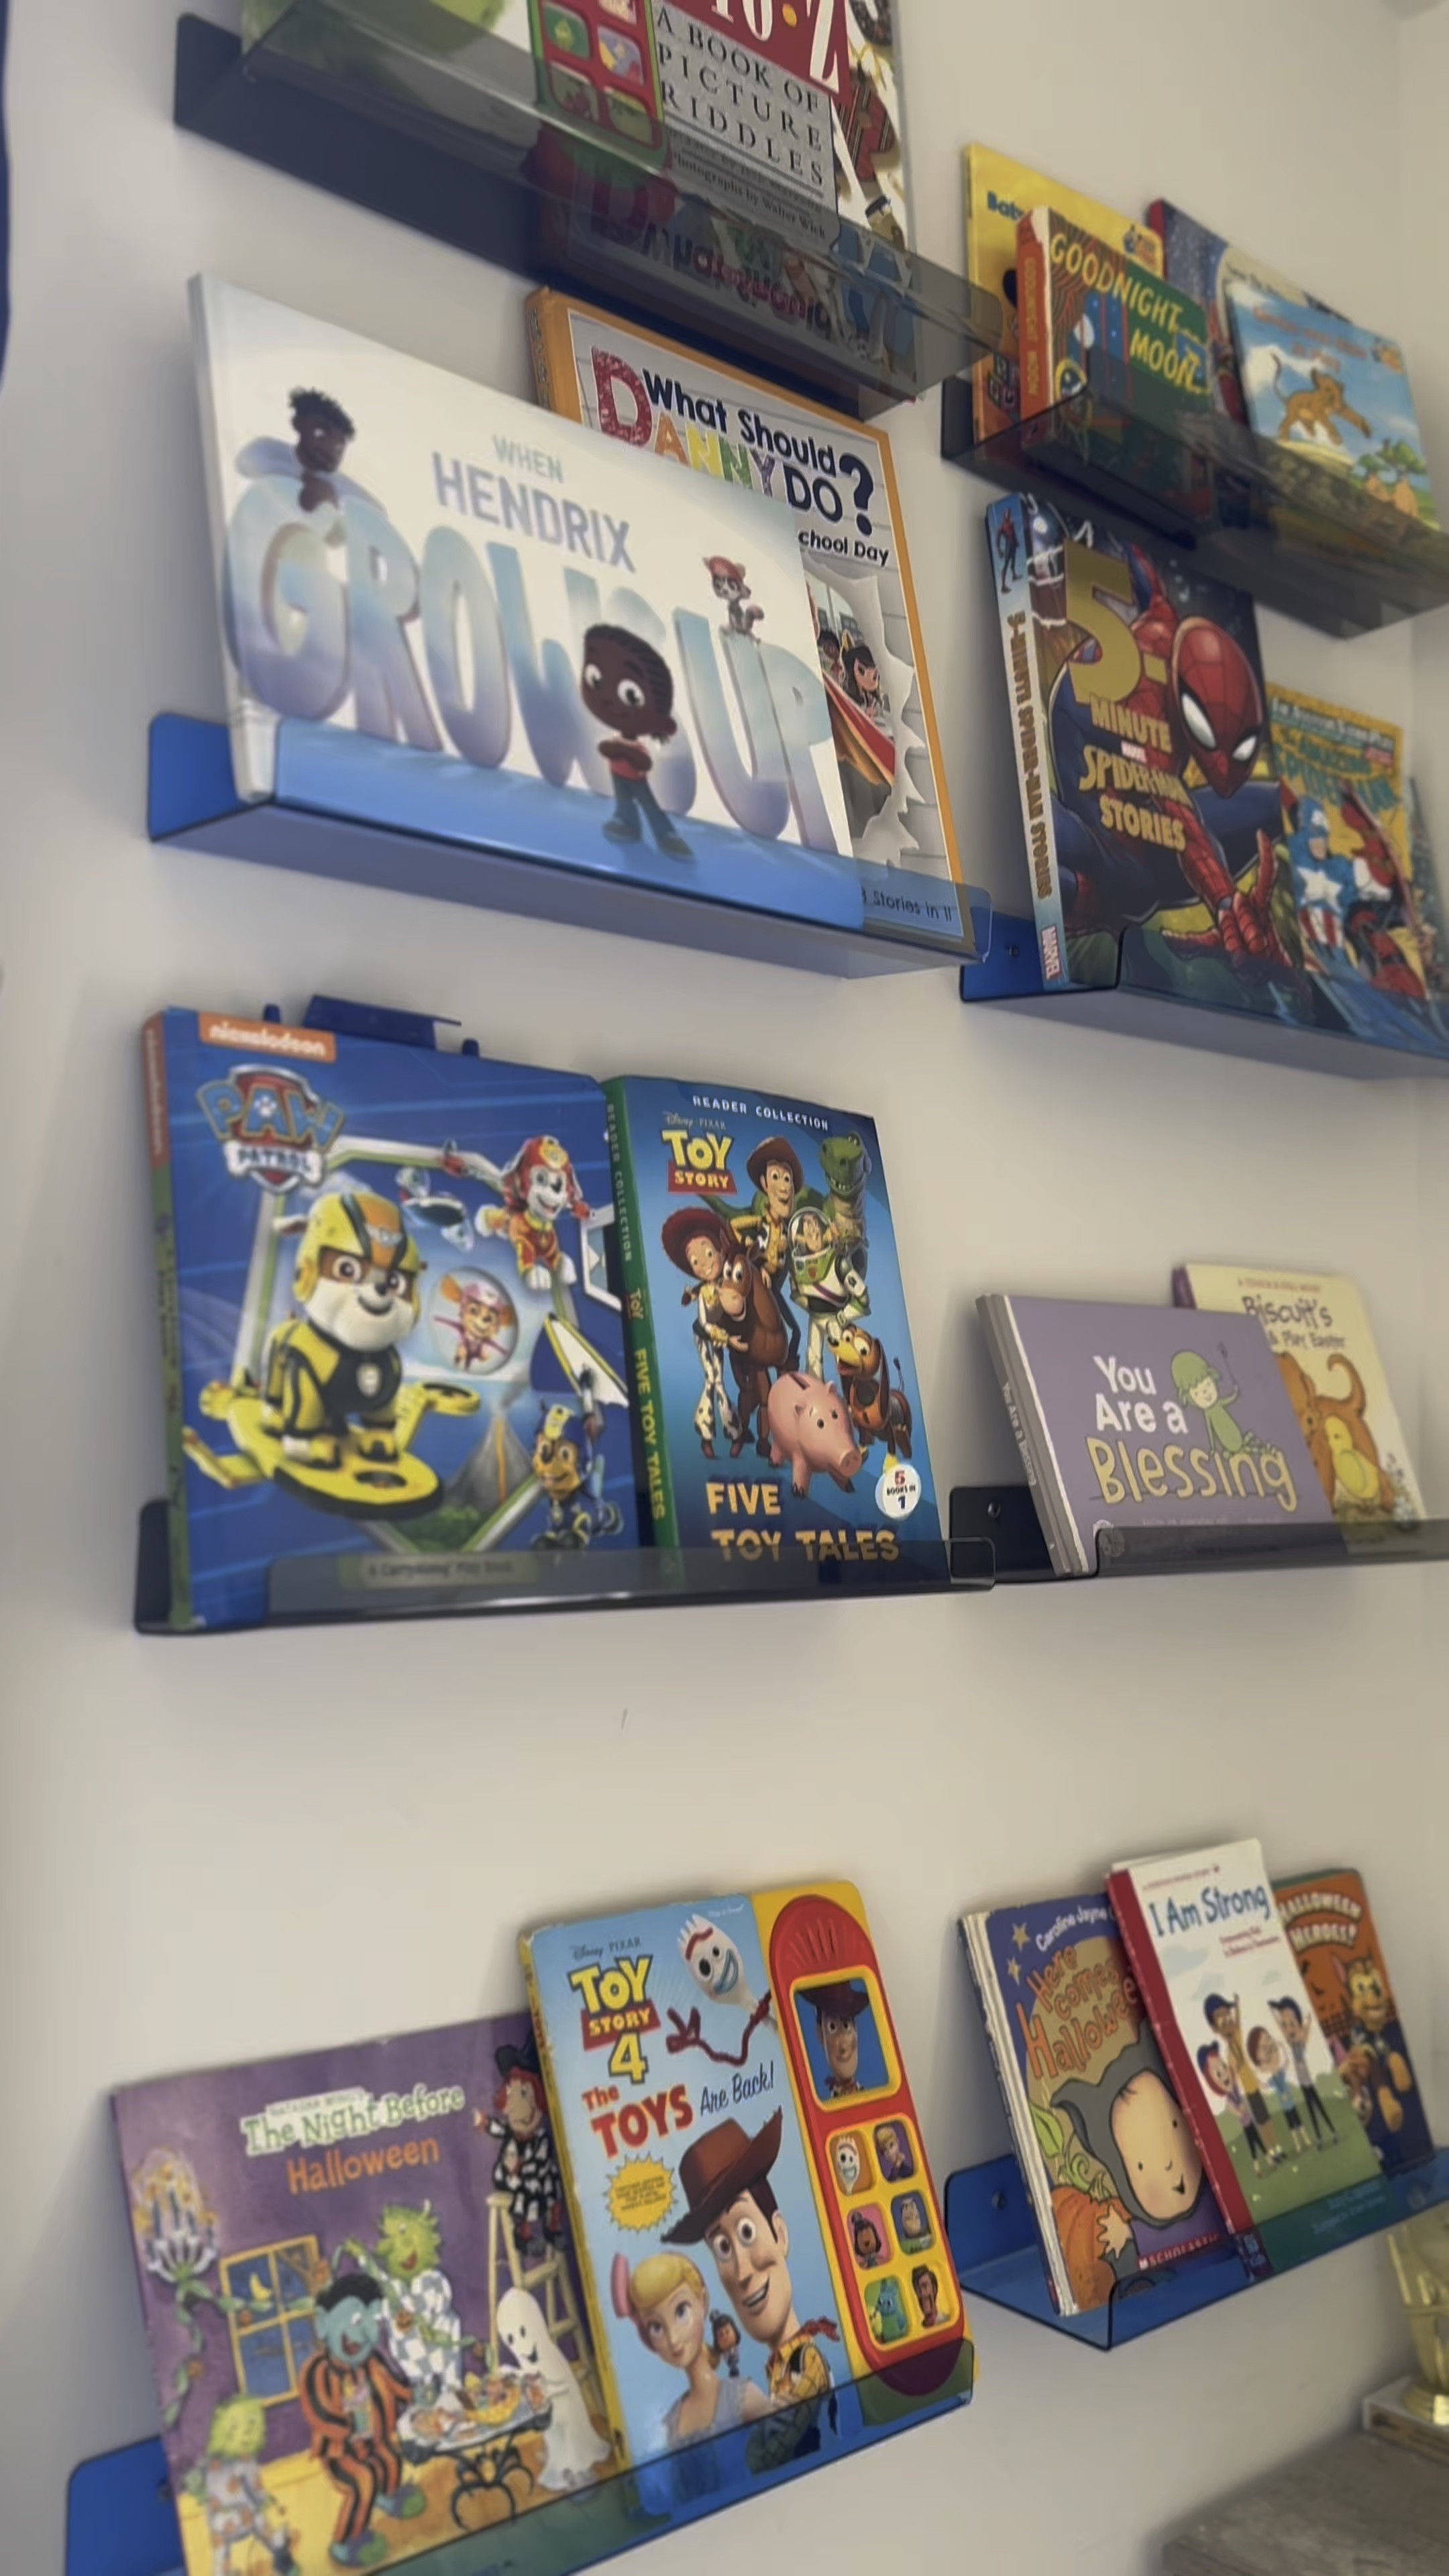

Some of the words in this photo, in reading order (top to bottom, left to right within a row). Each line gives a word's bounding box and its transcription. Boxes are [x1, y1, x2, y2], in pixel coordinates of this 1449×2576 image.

[657, 7, 674, 36] A
[687, 22, 772, 91] BOOK
[784, 78, 819, 113] OF
[657, 42, 822, 152] PICTURE
[661, 80, 823, 186] RIDDLES
[747, 187, 759, 207] by
[762, 195, 796, 223] Walter
[798, 213, 826, 239] Wick
[1050, 233, 1184, 333] GOODNIGHT
[1130, 327, 1210, 395] MOON
[591, 344, 775, 497] DANNY
[783, 451, 874, 537] DO?
[643, 368, 728, 433] What
[738, 408, 837, 477] Should
[492, 435, 564, 485] WHEN
[431, 451, 636, 573] HENDRIX
[798, 529, 849, 555] chool
[853, 540, 890, 567] Day
[672, 606, 842, 853] UP
[1089, 692, 1173, 755] MINUTE
[1078, 743, 1193, 809] SPIDER-MAN
[1099, 793, 1187, 853] STORIES
[873, 890, 921, 916] Stories
[925, 900, 940, 919] in
[196, 1079, 345, 1152] PAW
[692, 1095, 748, 1115] READER
[755, 1106, 829, 1132] COLLECTION
[606, 1102, 621, 1163] READER
[614, 1170, 633, 1263] COLLECTION
[674, 1171, 730, 1190] STORY
[633, 1346, 652, 1397] FIVE
[1093, 1355, 1157, 1397] You
[639, 1398, 658, 1447] TOY
[1008, 1404, 1021, 1428] Are
[1095, 1393, 1157, 1434] Are
[1163, 1399, 1189, 1435] a
[645, 1450, 666, 1521] TALES
[705, 1481, 782, 1516] FIVE
[886, 1484, 908, 1497] BOOKS
[898, 1495, 906, 1509] 1
[1085, 1436, 1297, 1513] Blessing
[710, 1529, 782, 1563] TOY
[795, 1528, 901, 1562] TALES
[1149, 1902, 1165, 1937] I
[1167, 1896, 1202, 1933] Am
[1201, 1884, 1273, 1924] Strong
[608, 1937, 641, 1952] PIXAR
[1026, 1945, 1077, 2013] Here
[1054, 1957, 1120, 2021] comes
[588, 2007, 651, 2037] STORY
[1016, 1976, 1139, 2080] Hallowee
[608, 2032, 649, 2085] 4
[700, 2086, 730, 2116] Are
[732, 2060, 774, 2103] Back!
[244, 2117, 295, 2154] The
[301, 2104, 380, 2143] Night
[385, 2084, 464, 2124] Before
[582, 2085, 620, 2111] The
[591, 2084, 694, 2159] TOYS
[286, 2137, 440, 2196] Halloween
